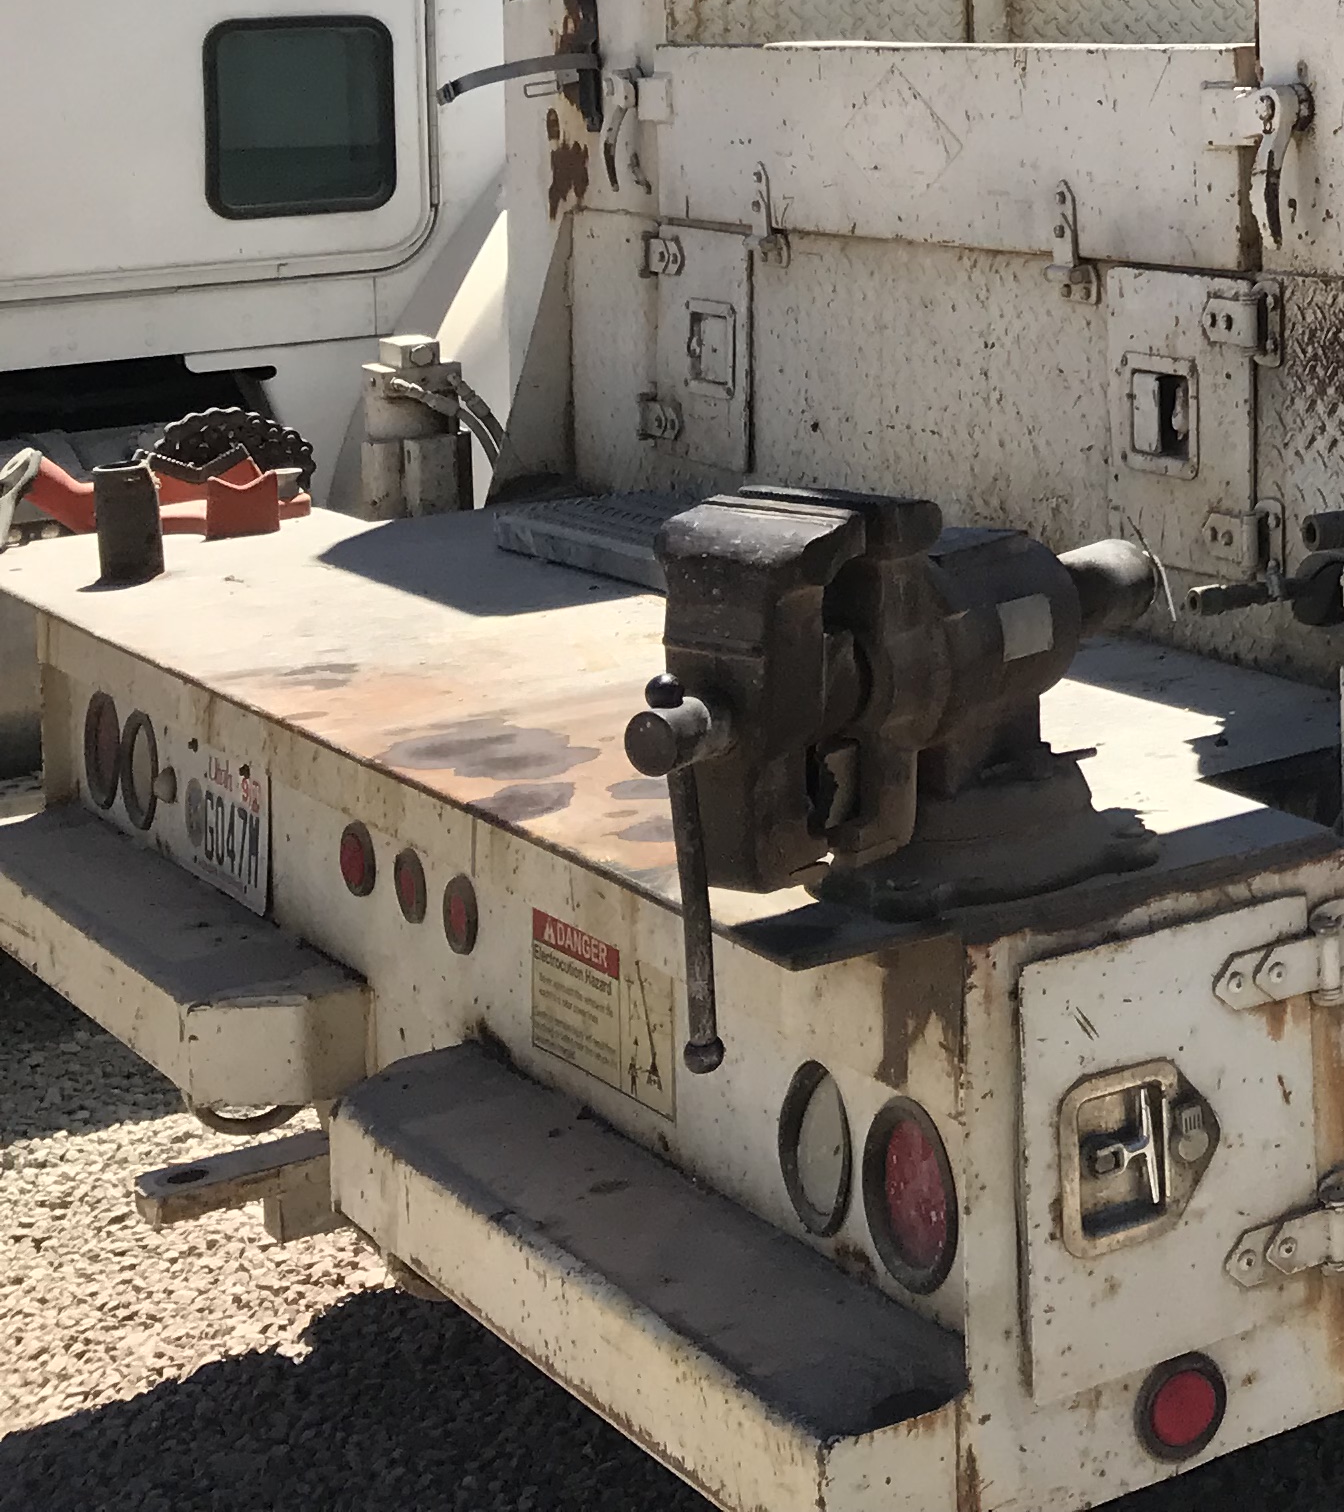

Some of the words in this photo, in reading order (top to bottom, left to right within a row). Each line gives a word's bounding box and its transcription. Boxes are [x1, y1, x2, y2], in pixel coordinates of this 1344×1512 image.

[208, 756, 232, 792] Utah
[556, 923, 608, 968] DANGER
[533, 944, 584, 982] Electrocution
[584, 968, 612, 996] Hazard
